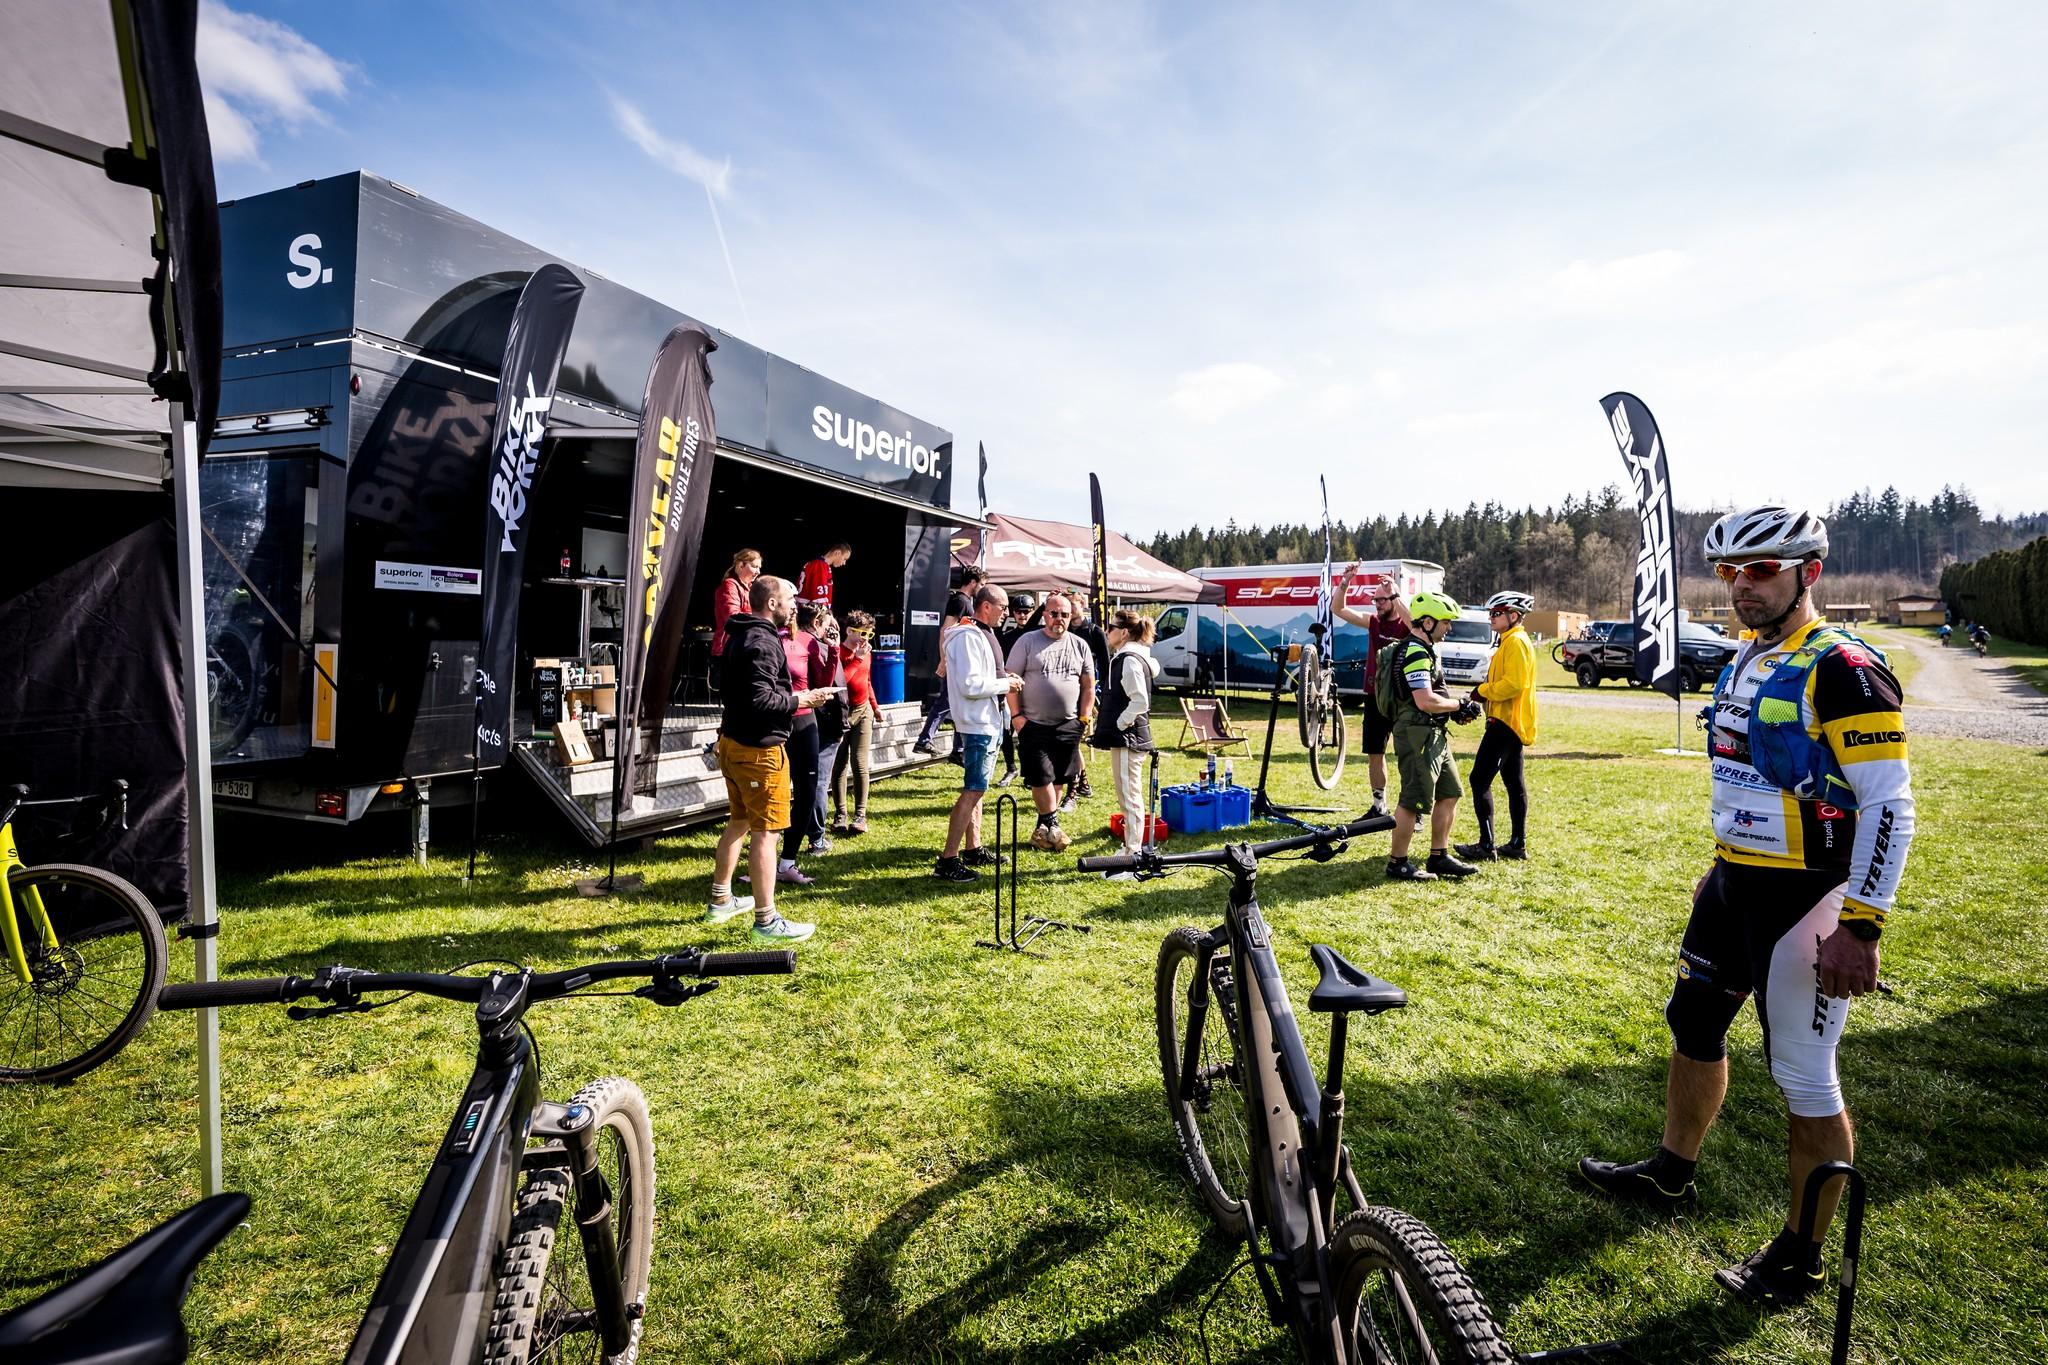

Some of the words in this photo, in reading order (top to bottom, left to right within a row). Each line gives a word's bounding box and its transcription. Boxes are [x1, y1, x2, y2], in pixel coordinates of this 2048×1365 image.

[286, 233, 333, 289] S.
[491, 395, 524, 521] BIKE
[500, 371, 552, 552] WORKX
[811, 405, 942, 480] superior.
[670, 461, 691, 532] BICYCLE
[682, 416, 700, 463] TIRES
[380, 568, 424, 578] superior.
[1236, 585, 1381, 599] SUPEOR
[1855, 667, 1871, 697] sport.cz
[228, 781, 249, 797] 5383
[1824, 820, 1834, 848] sport.cz
[1859, 804, 1895, 898] STEVENS
